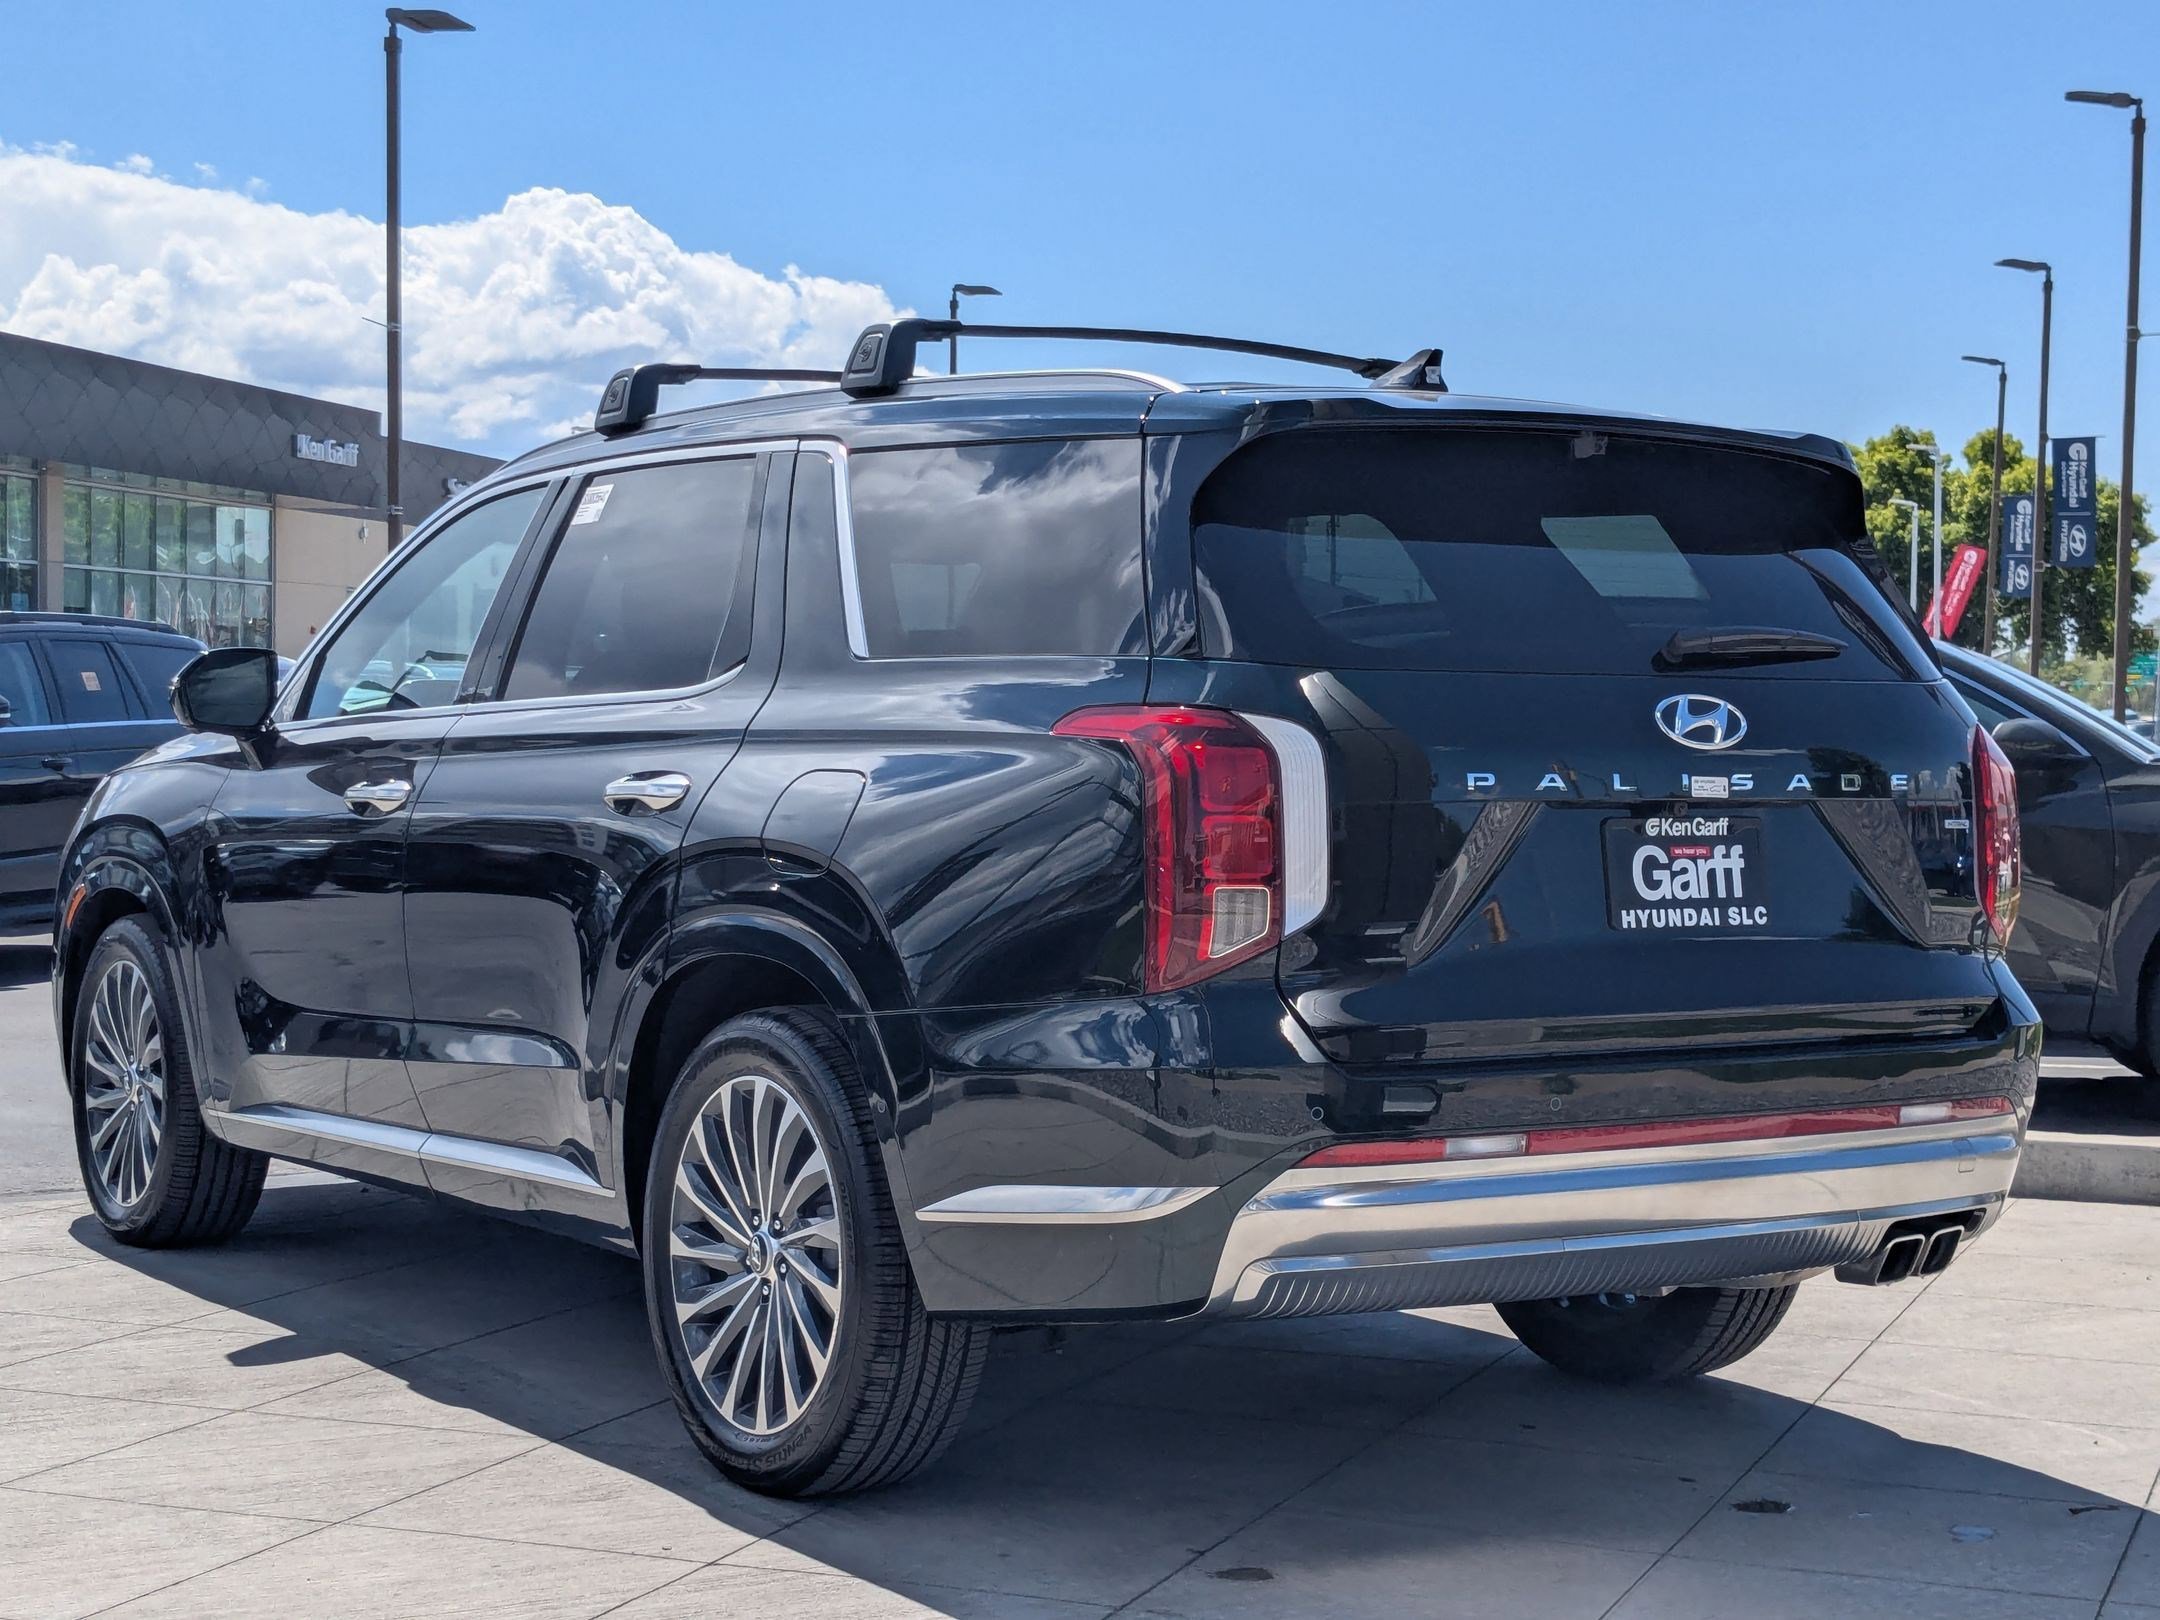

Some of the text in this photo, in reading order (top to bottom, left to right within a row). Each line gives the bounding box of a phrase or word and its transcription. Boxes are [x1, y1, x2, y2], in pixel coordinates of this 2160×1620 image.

[2066, 461, 2080, 508] Hyundai
[1465, 771, 1911, 794] PALISADE
[1632, 844, 1745, 902] Garff
[1620, 905, 1768, 929] HYUNDAI SLC
